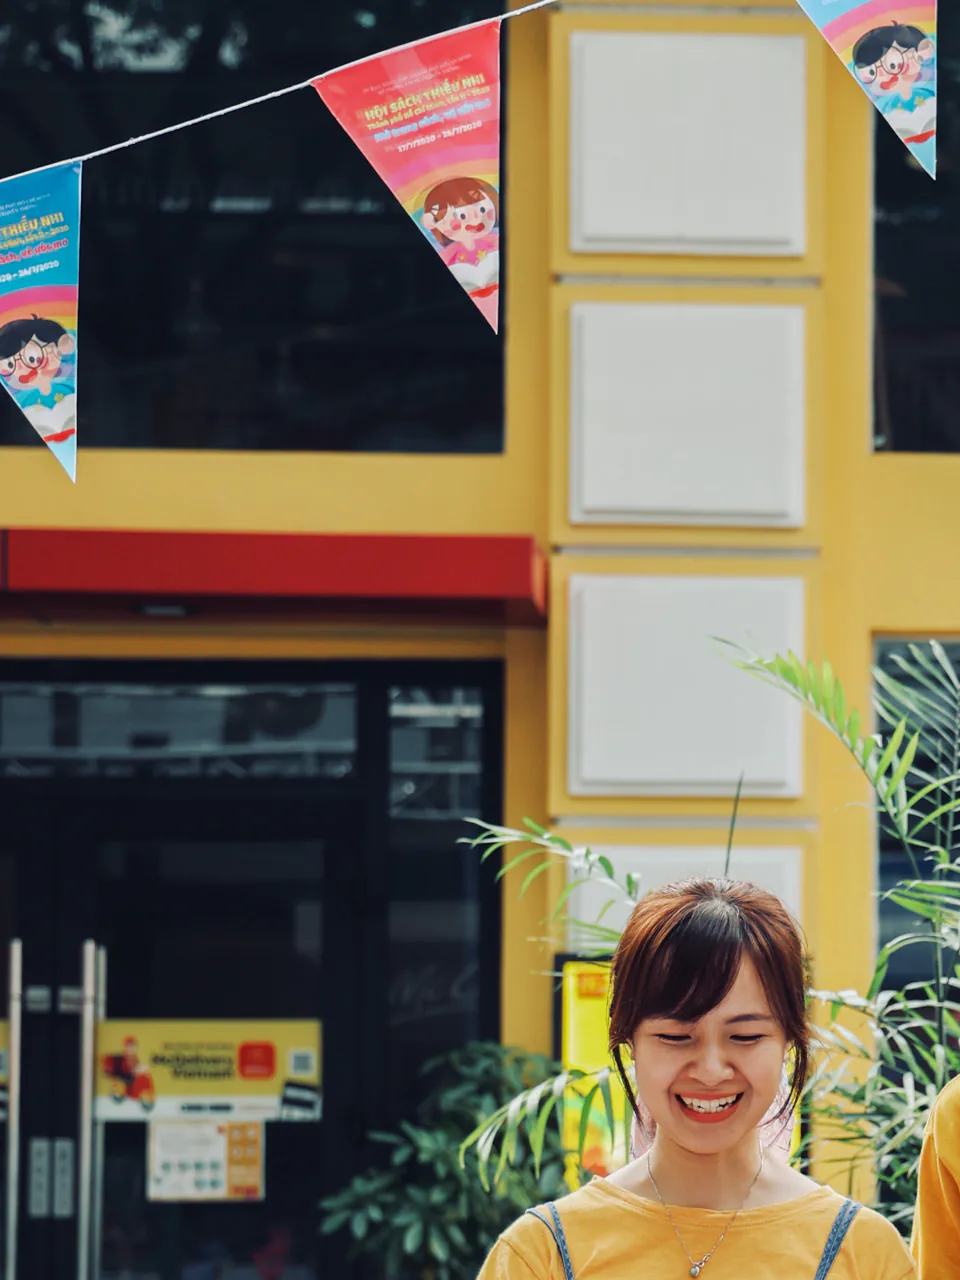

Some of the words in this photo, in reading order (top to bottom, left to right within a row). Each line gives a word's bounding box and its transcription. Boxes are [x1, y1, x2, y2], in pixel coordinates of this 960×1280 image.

[461, 73, 485, 89] NHI
[1, 214, 38, 238] THIẾU
[40, 211, 64, 227] NHI
